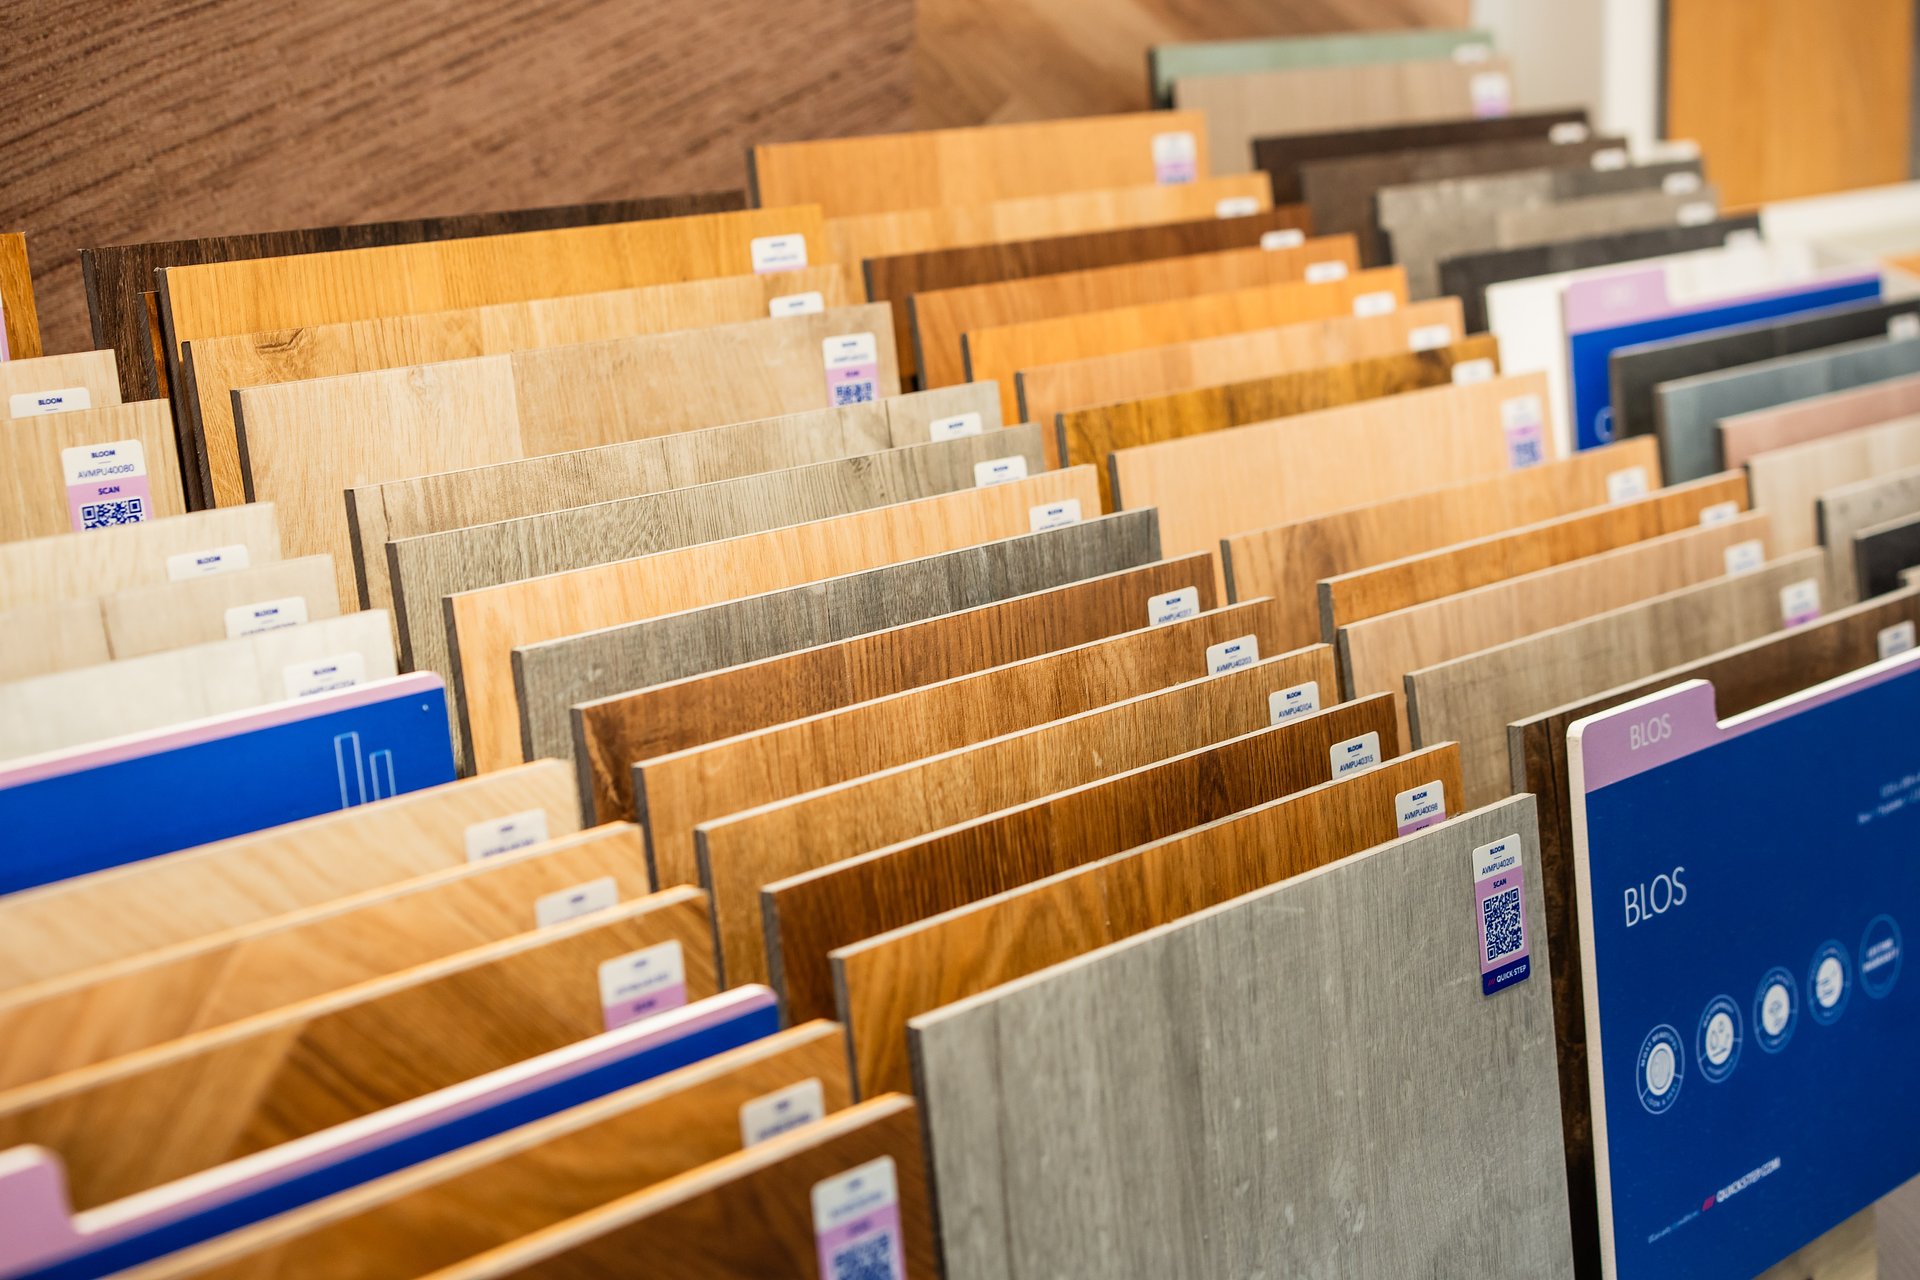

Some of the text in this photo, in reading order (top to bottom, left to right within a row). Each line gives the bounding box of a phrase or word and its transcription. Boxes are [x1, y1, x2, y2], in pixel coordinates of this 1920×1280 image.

[38, 397, 63, 405] BLOOM
[91, 449, 116, 459] BLOOM
[77, 463, 135, 479] AVMPU40080
[98, 485, 120, 496] SCAN
[1224, 645, 1240, 655] BLOOM
[1286, 690, 1302, 700] BLOOM
[1630, 712, 1672, 750] BLOS
[1347, 743, 1363, 753] BLOOM
[1339, 753, 1374, 773] AVMPU40315
[1412, 791, 1428, 802] BLOOM
[1489, 844, 1505, 855] BLOOM
[1481, 856, 1515, 875] AVMPU40201
[1493, 878, 1507, 889] SCAN
[1624, 866, 1688, 928] BLOS
